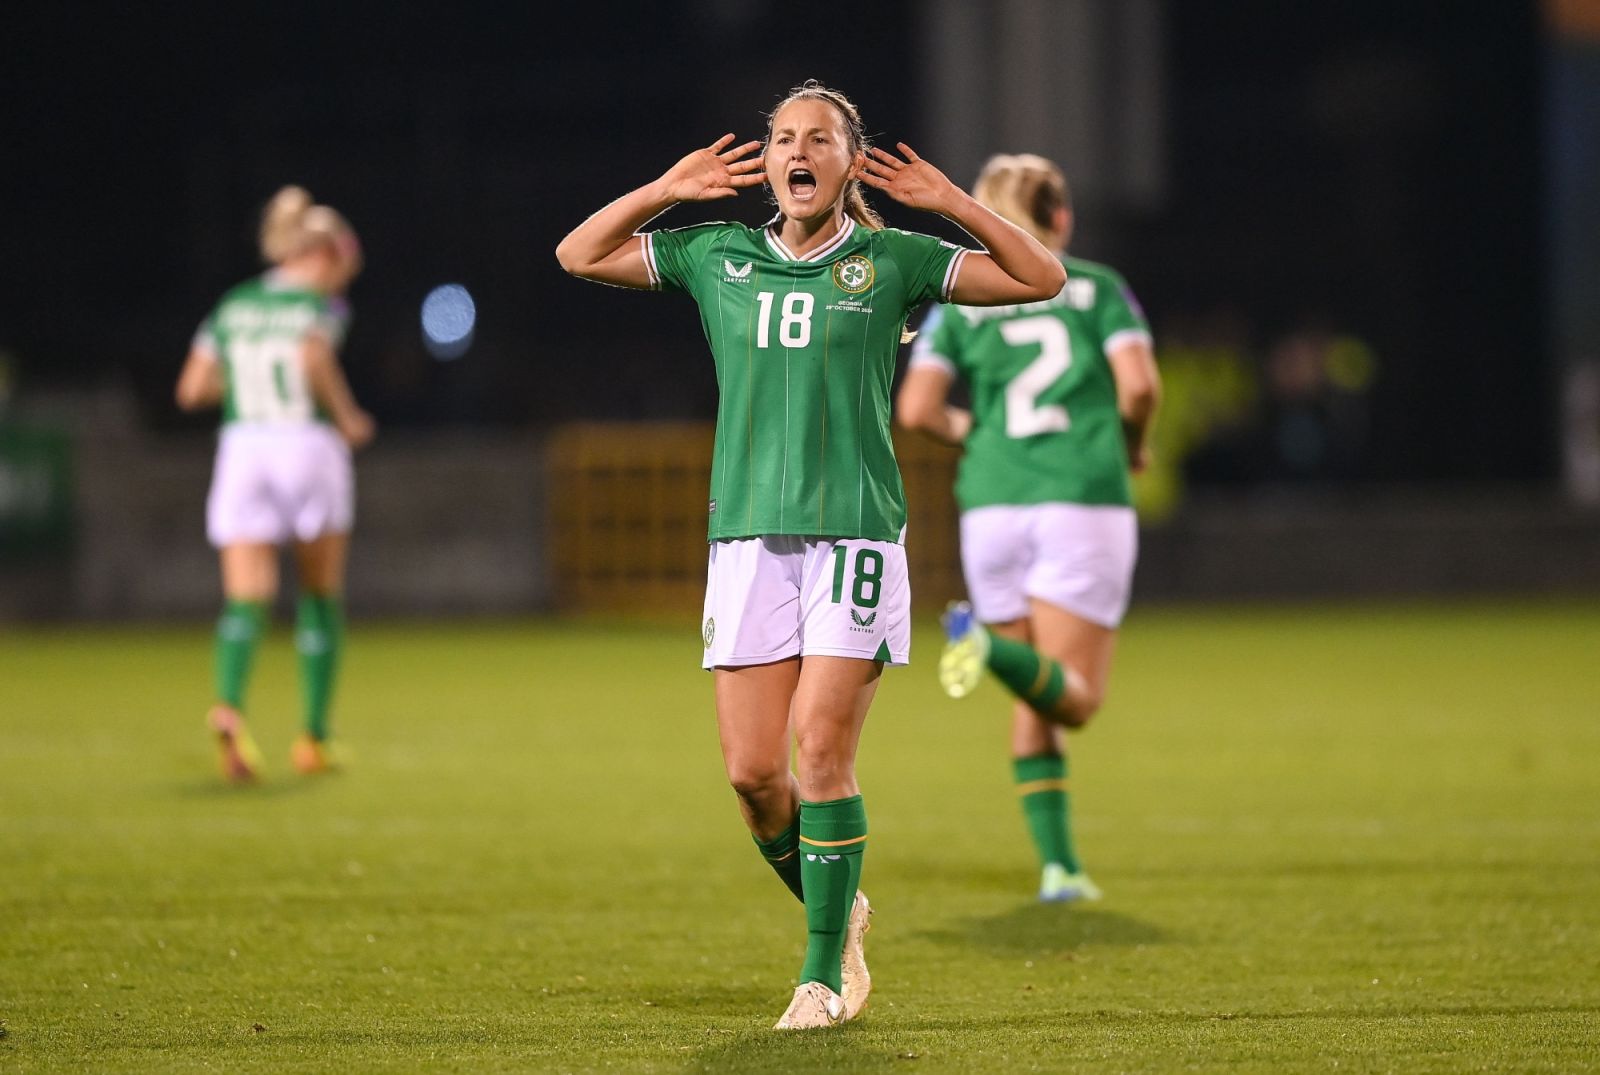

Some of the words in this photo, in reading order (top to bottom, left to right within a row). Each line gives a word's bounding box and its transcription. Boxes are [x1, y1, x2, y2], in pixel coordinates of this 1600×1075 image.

[756, 291, 815, 349] 18
[231, 339, 310, 420] 10
[999, 315, 1072, 439] 2
[832, 545, 884, 609] 18
